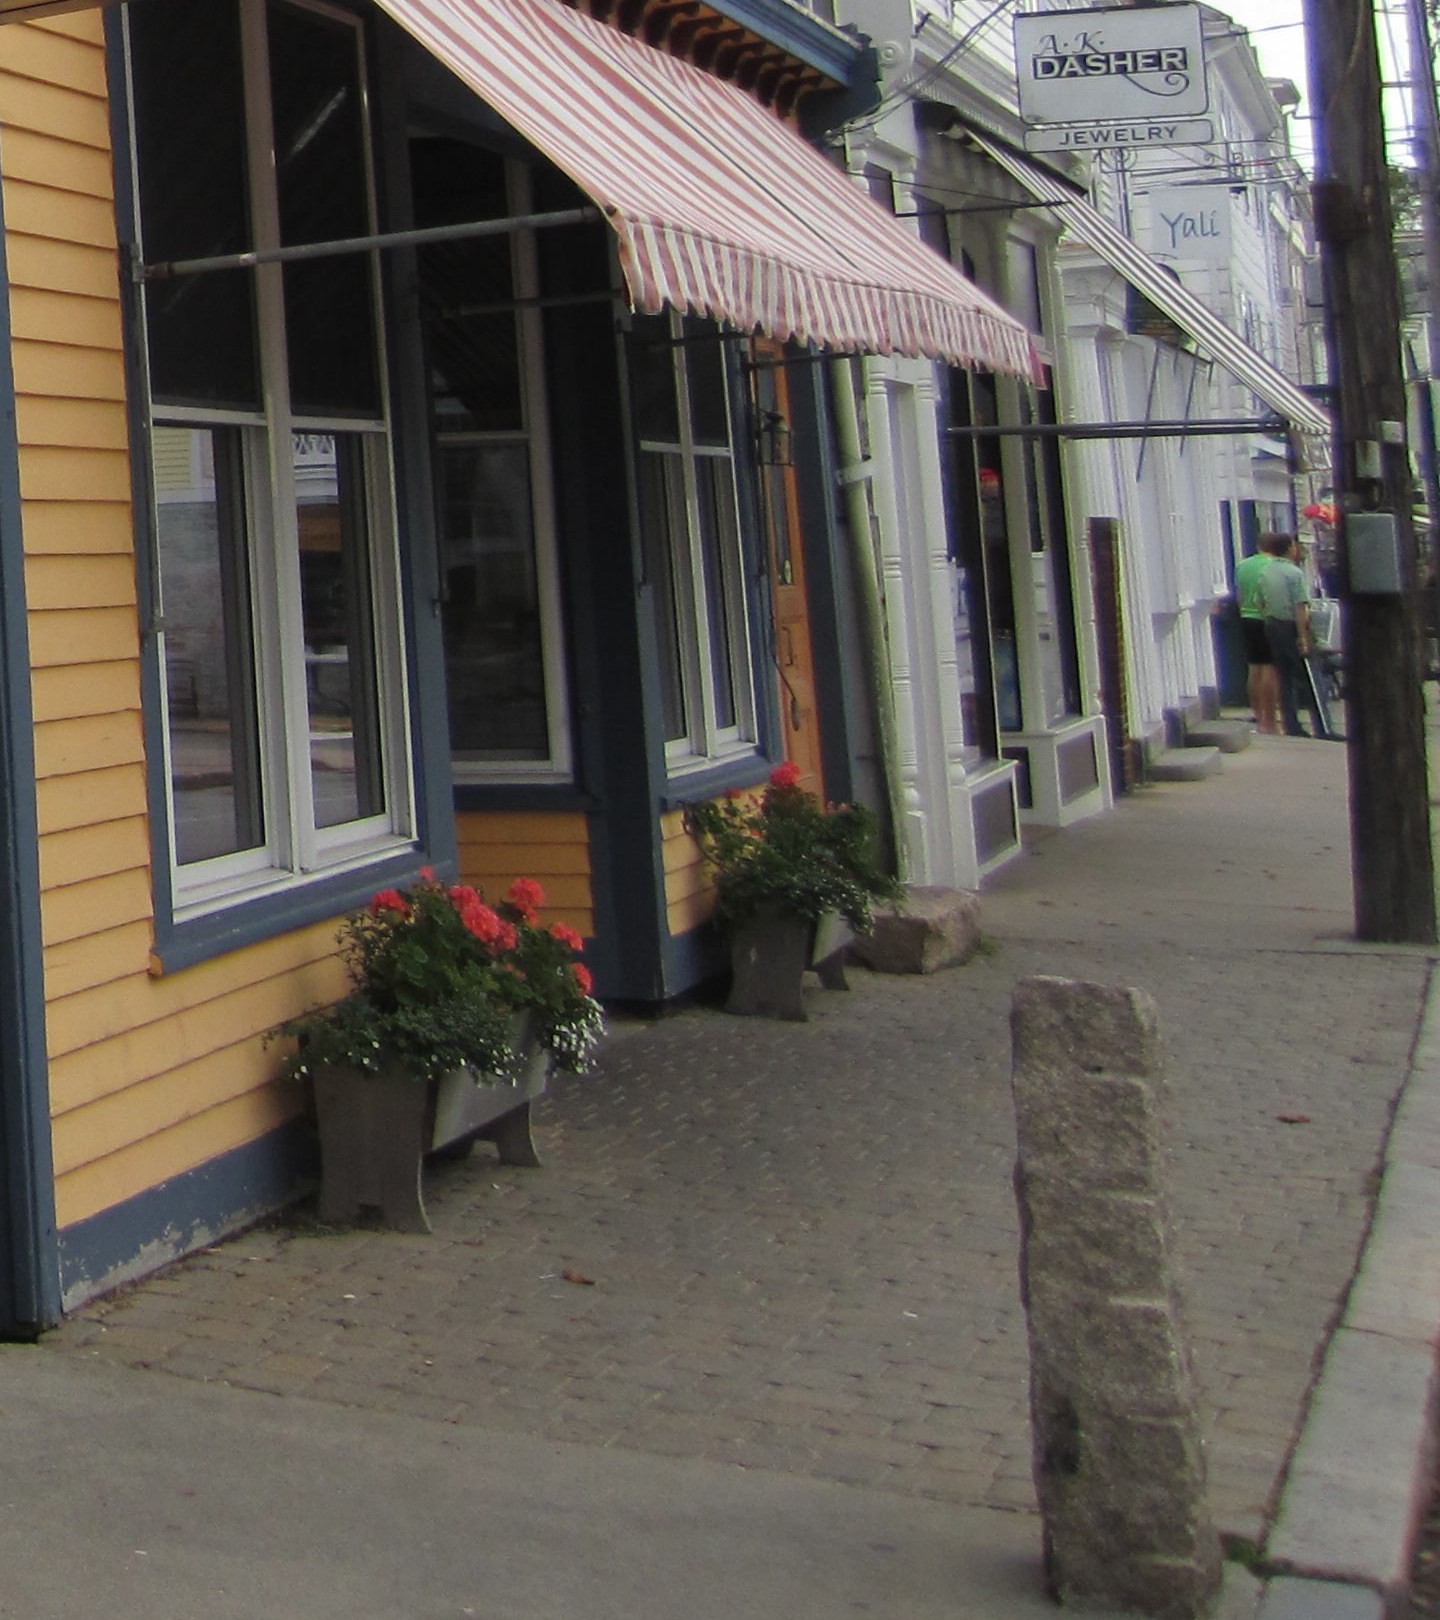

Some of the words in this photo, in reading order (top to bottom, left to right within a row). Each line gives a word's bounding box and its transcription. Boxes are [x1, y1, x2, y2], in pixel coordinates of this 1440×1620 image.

[1035, 49, 1186, 79] DASHER
[1059, 125, 1178, 146] JEWELRY
[1161, 209, 1221, 248] Yali
